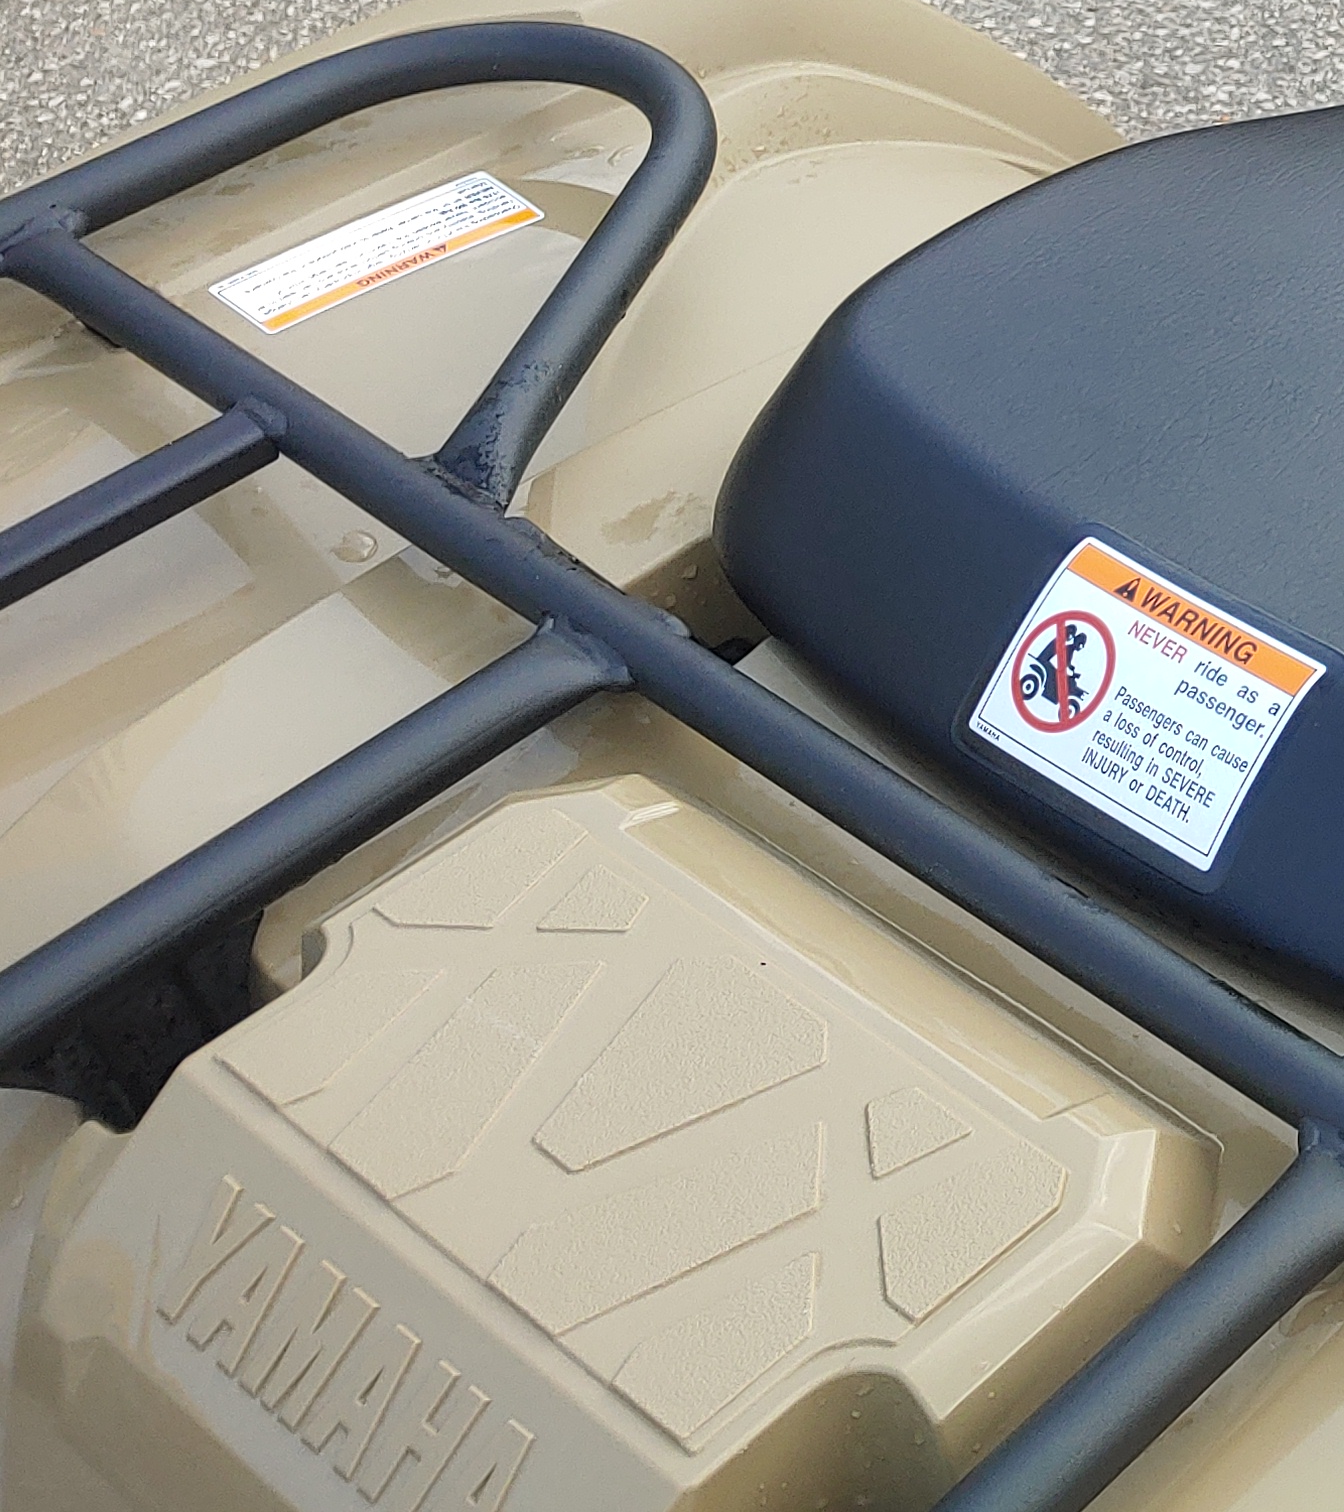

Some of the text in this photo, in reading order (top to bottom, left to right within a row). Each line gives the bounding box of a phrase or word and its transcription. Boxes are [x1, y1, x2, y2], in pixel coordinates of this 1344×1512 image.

[1140, 586, 1257, 665] WARNING
[1126, 619, 1281, 717] NEVER ride as a
[975, 720, 1001, 742] YAMAHA
[1101, 708, 1205, 779] a loss of control,
[1113, 684, 1249, 773] Passengers can cause
[1172, 678, 1265, 738] passenger.
[1080, 745, 1191, 824] INJURY or DEATH.
[1091, 729, 1216, 808] resulting in SEVERE
